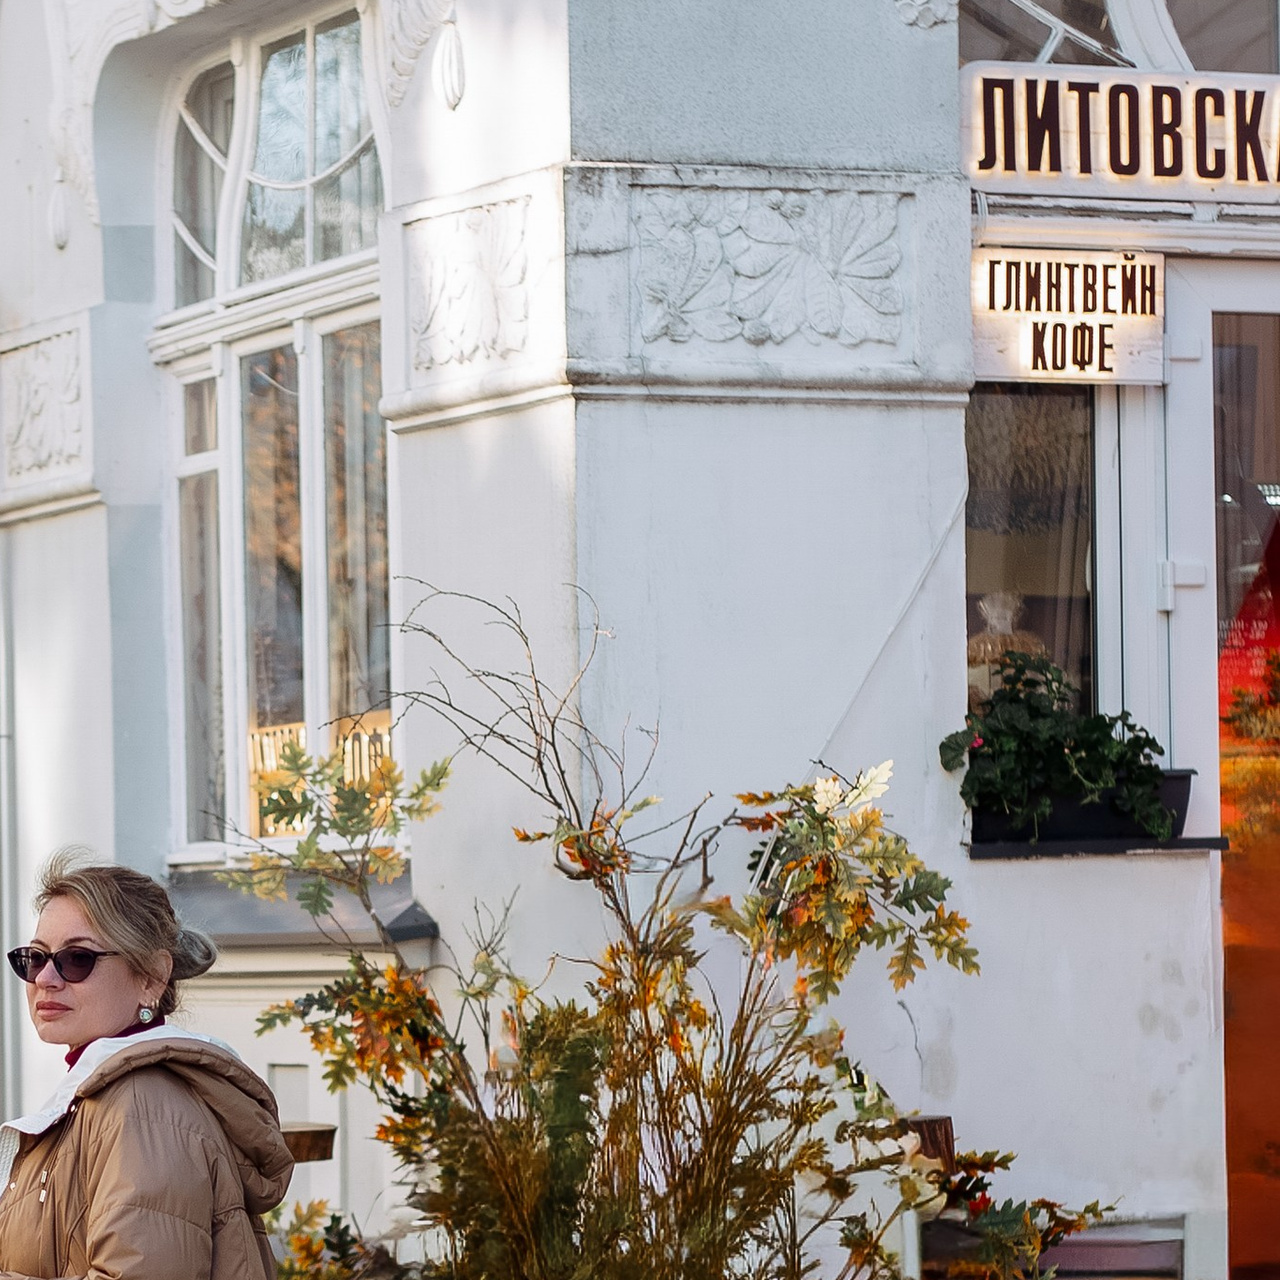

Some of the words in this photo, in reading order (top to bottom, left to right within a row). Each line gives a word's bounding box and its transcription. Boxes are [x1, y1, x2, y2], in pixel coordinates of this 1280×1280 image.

[978, 77, 1280, 183] ЛИТОВСК
[988, 253, 1156, 316] ГЛИНТВЕЙН
[1031, 321, 1114, 372] КОФЕ
